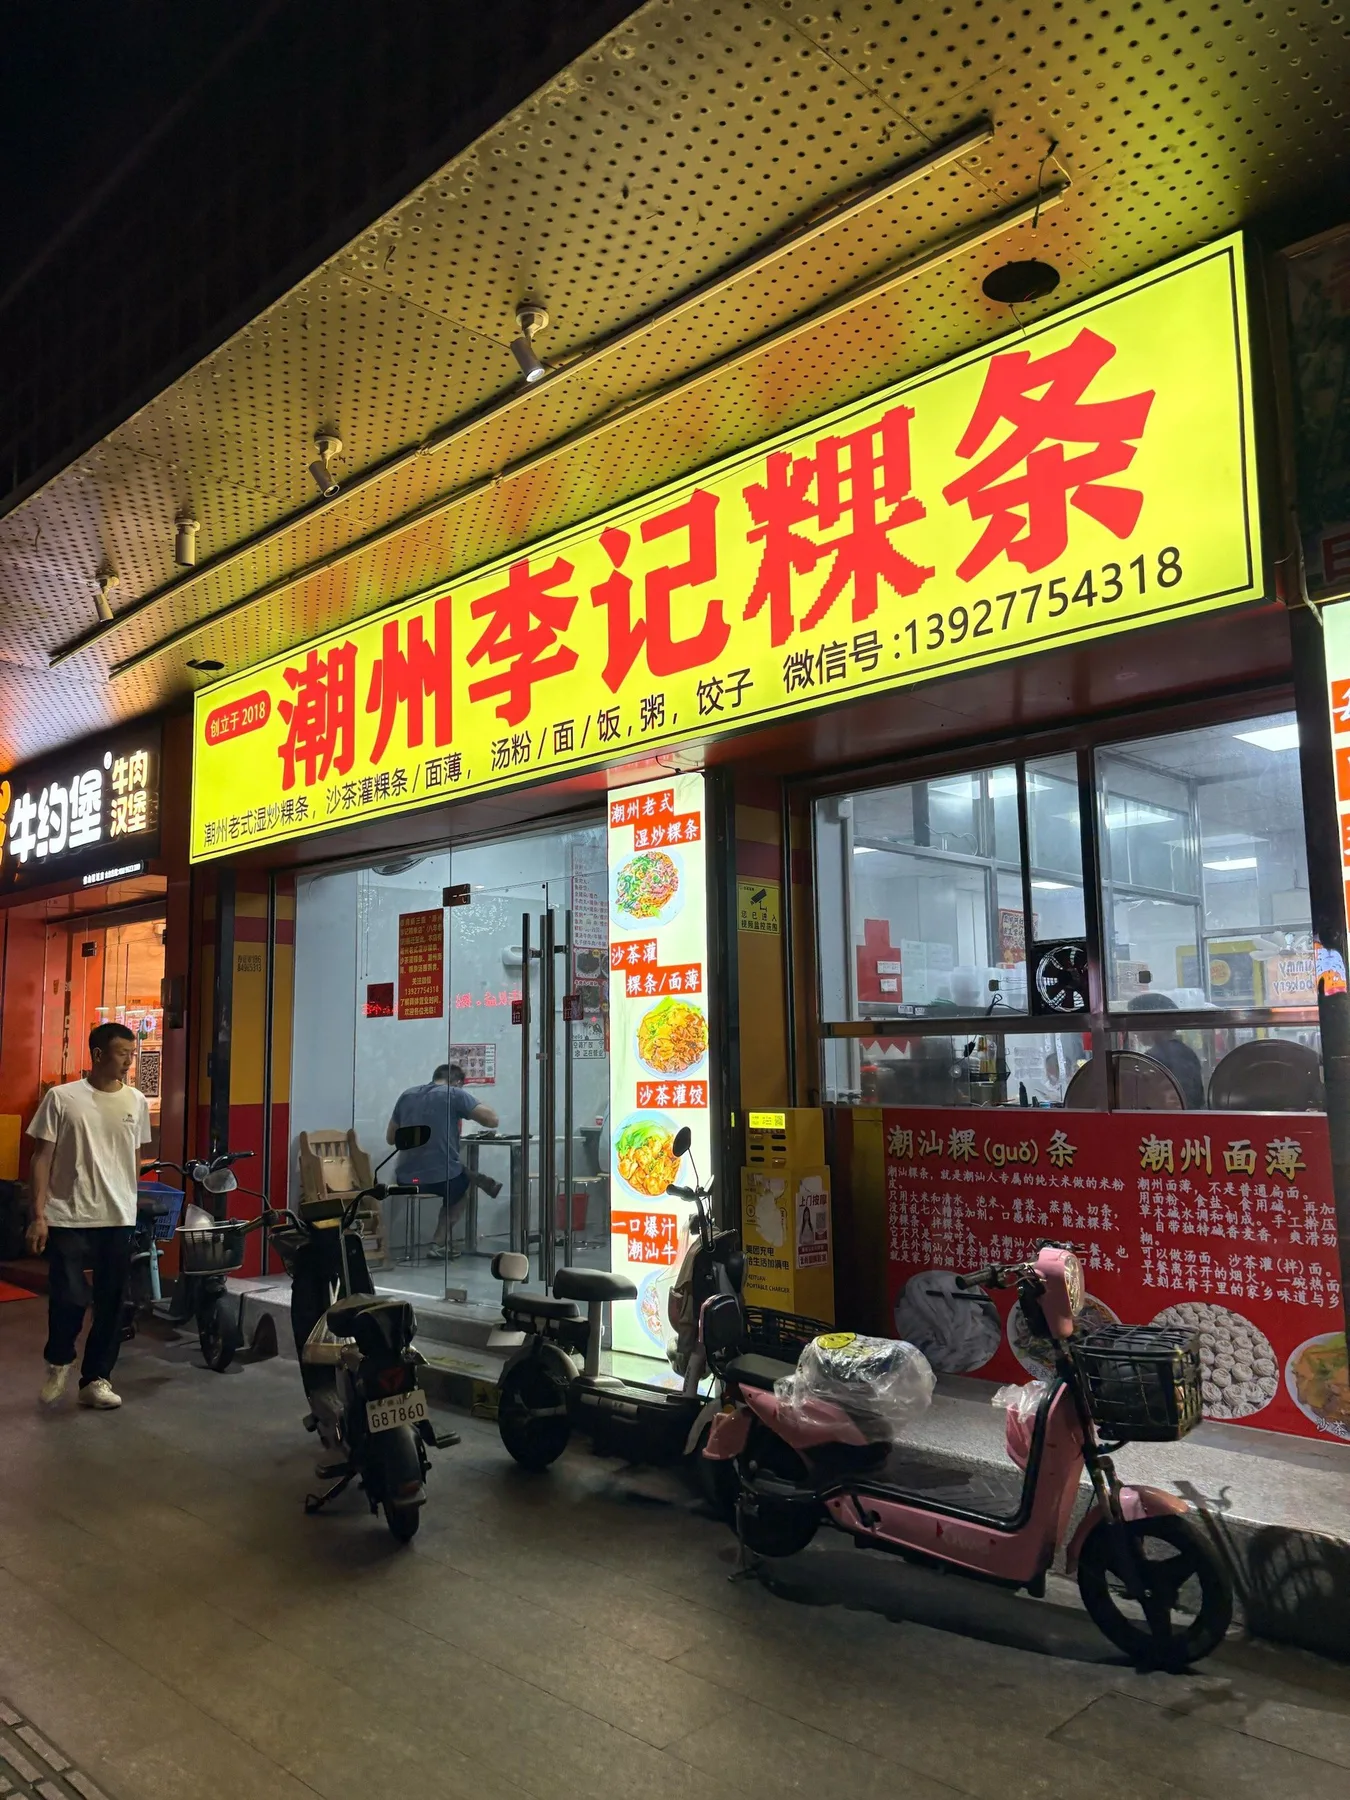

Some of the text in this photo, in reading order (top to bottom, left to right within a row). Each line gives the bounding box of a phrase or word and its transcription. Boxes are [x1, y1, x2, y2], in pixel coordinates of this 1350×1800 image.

[276, 327, 1156, 791] 潮州李记粿条
[210, 702, 266, 737] 创立于 2018
[111, 750, 148, 795] 牛肉
[9, 769, 102, 863] 牛约堡
[110, 790, 147, 838] 汉堡
[611, 792, 674, 822] 潮州老式
[635, 818, 699, 848] 湿炒粿条
[741, 910, 777, 922] 您已进入
[741, 920, 778, 931] 视频监控范围
[611, 942, 657, 966] 沙茶灌
[405, 985, 439, 996] 13927754318
[626, 968, 700, 996] 粿条/面薄
[639, 1081, 705, 1107] 沙茶灌饺
[1139, 1134, 1306, 1180] 潮州面薄
[799, 1194, 828, 1207] 上门按摩
[612, 1215, 675, 1240] 一口爆汁
[628, 1238, 678, 1264] 潮汕牛
[769, 1285, 790, 1294] CHARGER
[371, 1402, 424, 1428] G87860
